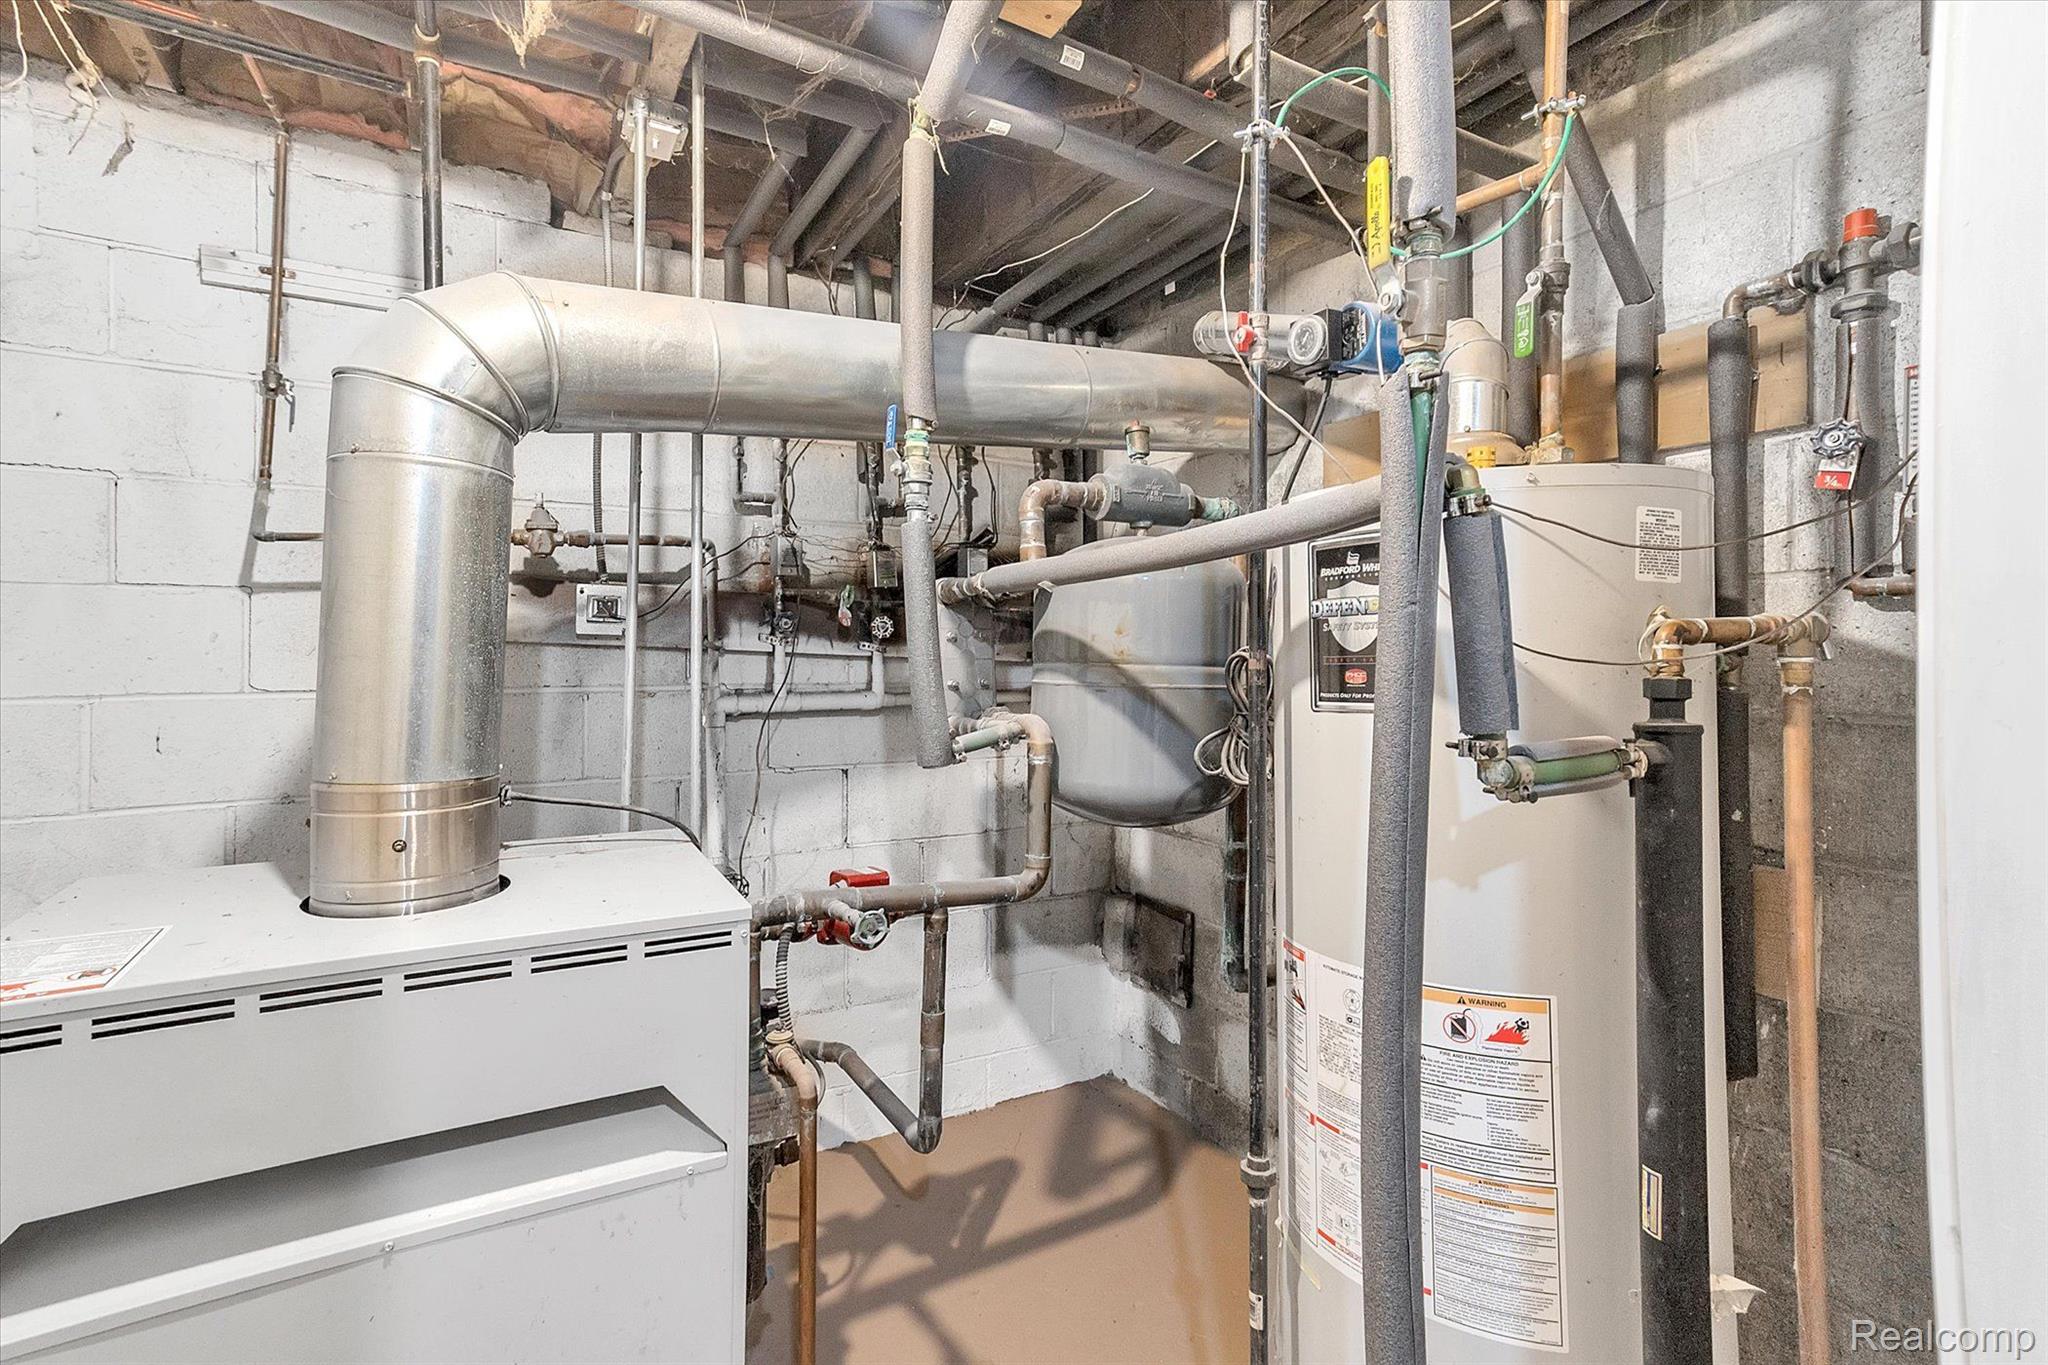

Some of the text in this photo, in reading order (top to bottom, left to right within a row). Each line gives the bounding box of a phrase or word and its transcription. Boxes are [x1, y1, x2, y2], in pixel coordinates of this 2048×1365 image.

[1320, 562, 1380, 577] BRADFORD WHI
[1468, 997, 1507, 1009] WARNING
[1464, 1055, 1496, 1064] EXPLOSION
[1496, 1059, 1520, 1067] HAZARD
